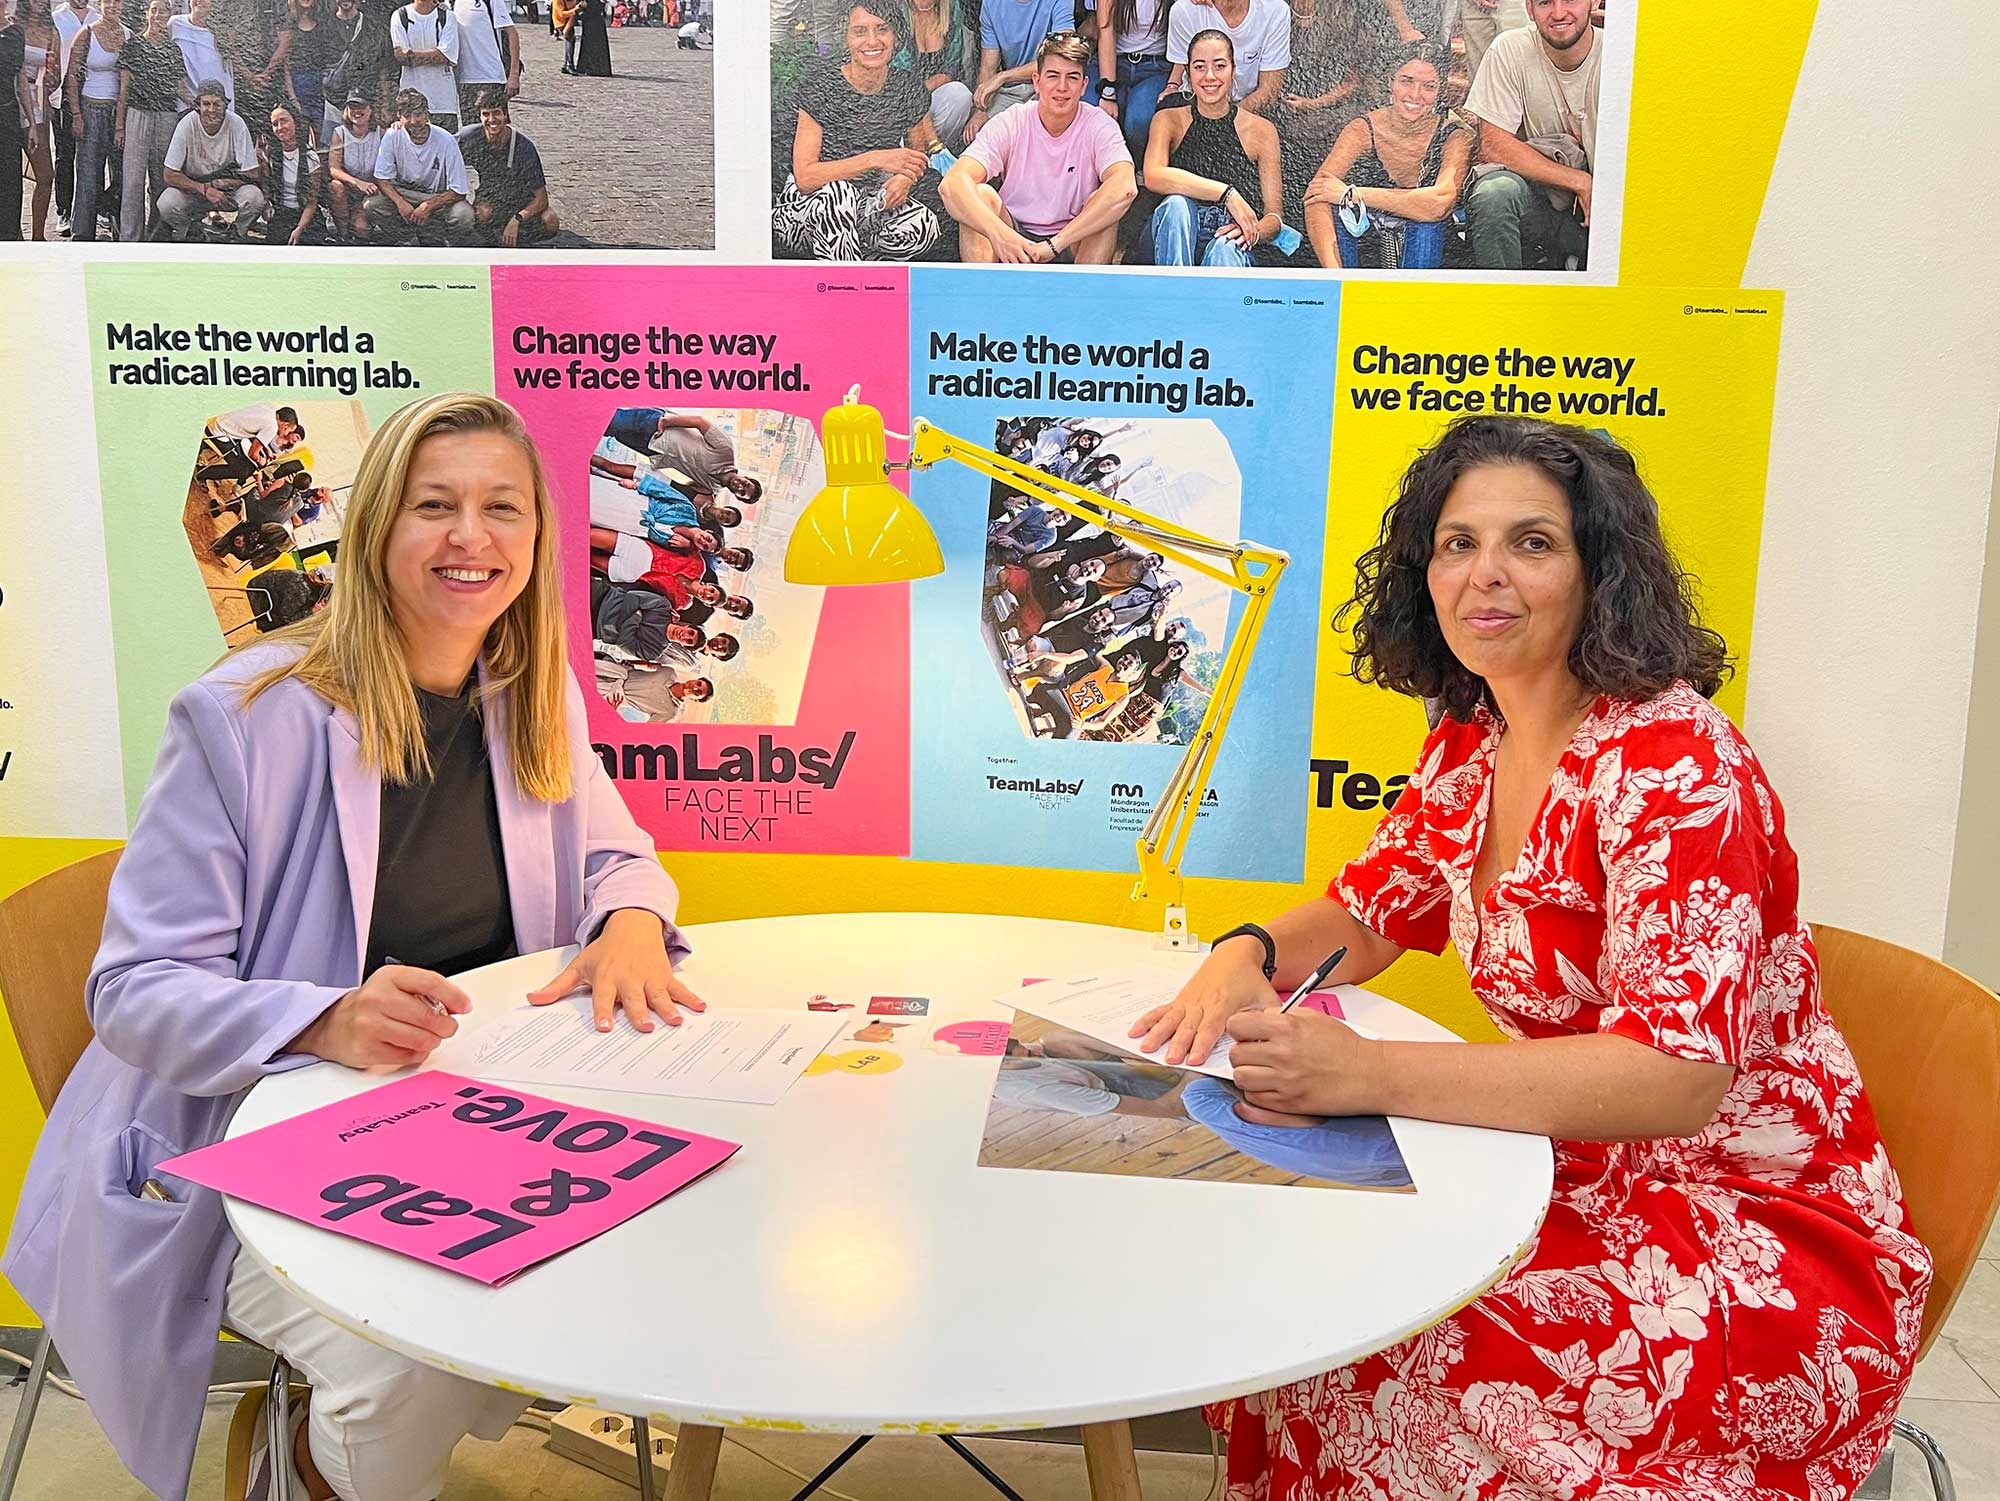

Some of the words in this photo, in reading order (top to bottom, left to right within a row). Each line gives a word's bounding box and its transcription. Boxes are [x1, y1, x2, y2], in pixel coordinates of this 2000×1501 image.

[106, 322, 191, 352] Make
[195, 323, 252, 352] the
[256, 325, 349, 354] world
[355, 332, 375, 354] a
[512, 325, 641, 365] Change
[644, 325, 704, 356] the
[707, 334, 778, 364] way
[929, 331, 1018, 363] Make
[1022, 334, 1082, 366] the
[1086, 339, 1184, 370] world
[1188, 347, 1210, 370] a
[109, 356, 218, 386] radical
[223, 358, 358, 396] learning
[363, 360, 420, 389] lab.
[512, 367, 562, 390] we
[565, 357, 641, 390] face
[644, 361, 703, 391] the
[707, 360, 811, 392] world.
[1353, 344, 1490, 385] Change
[1494, 347, 1556, 378] the
[1562, 356, 1636, 389] way
[928, 367, 1042, 400] radical
[1048, 371, 1188, 414] learning
[1194, 376, 1254, 408] lab.
[1350, 388, 1401, 411] we
[1406, 379, 1485, 412] face
[1490, 383, 1552, 414] the
[1557, 386, 1666, 417] world.
[664, 786, 744, 814] FACE
[752, 788, 814, 815] THE
[986, 775, 1085, 796] TeamLabs/
[1029, 792, 1052, 802] FACE
[1055, 794, 1072, 803] THE
[1110, 798, 1150, 807] Mondragon
[1039, 801, 1061, 810] NEXT
[700, 815, 779, 842] NEXT
[847, 1054, 881, 1070] LAB
[455, 1086, 692, 1181] Love.
[510, 1168, 612, 1217] &
[319, 1174, 536, 1260] Lab
